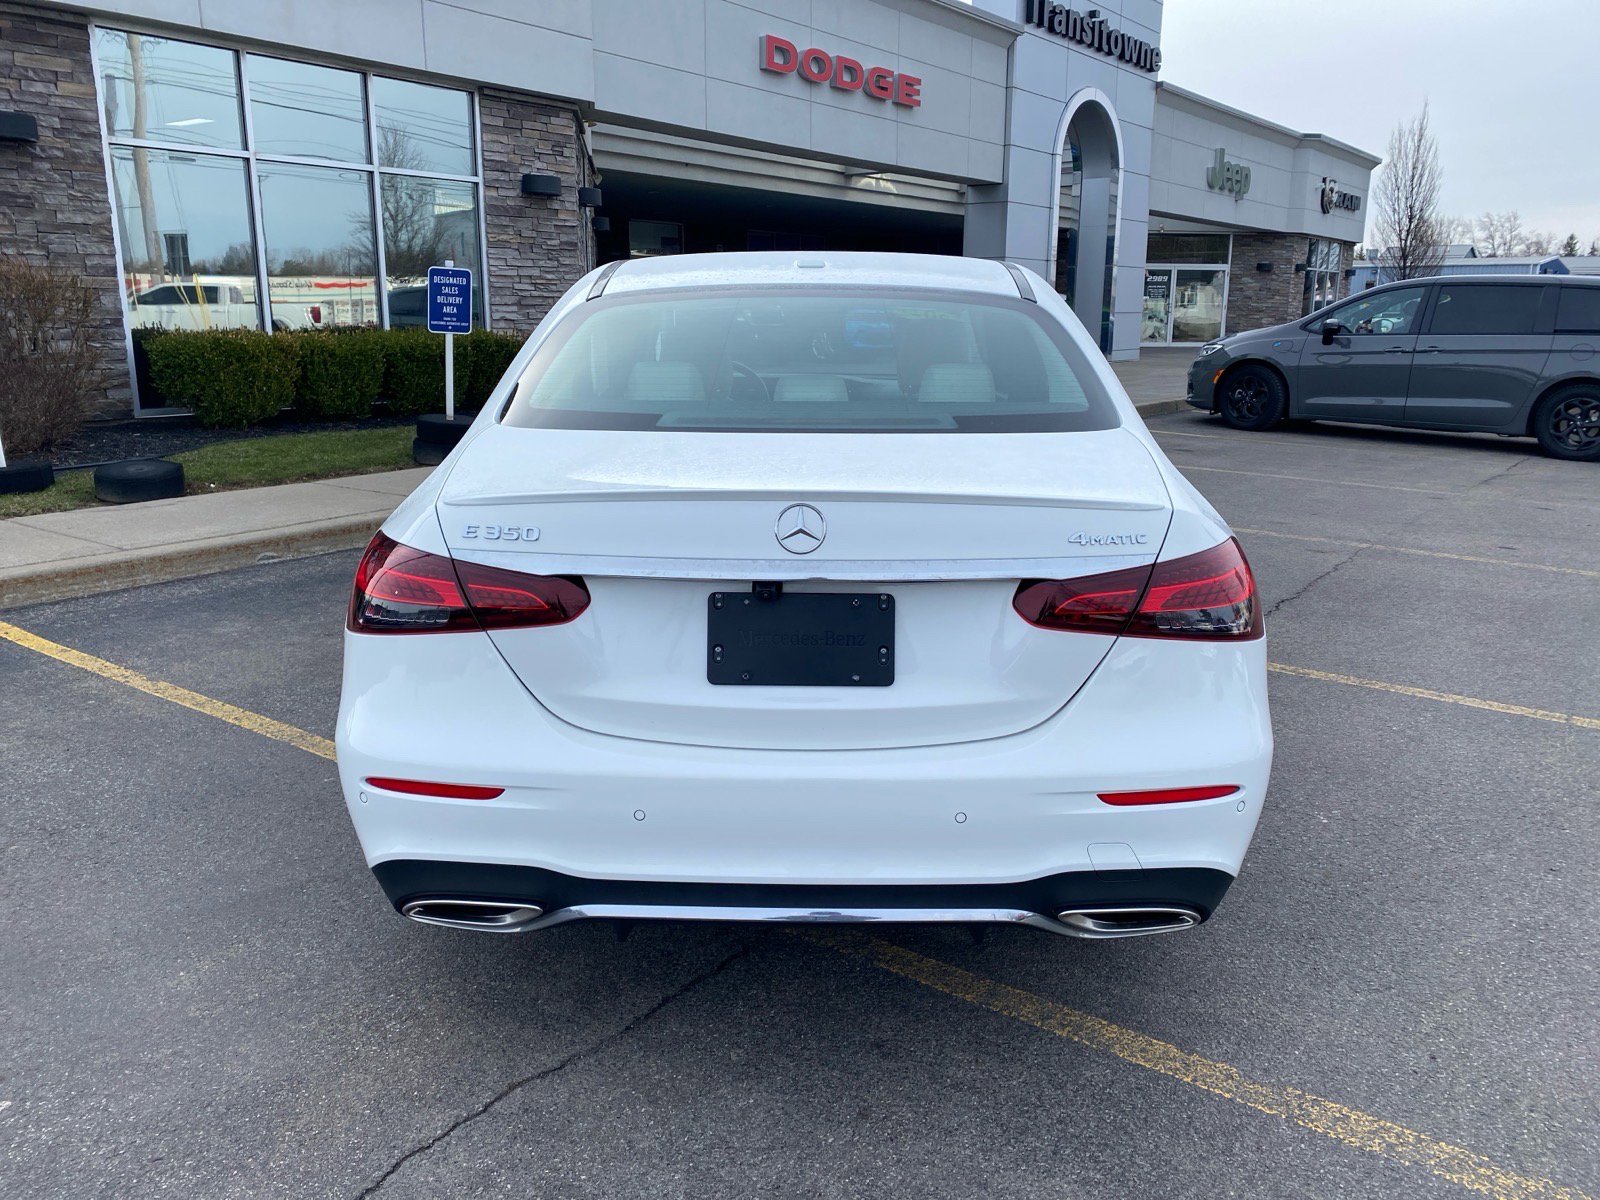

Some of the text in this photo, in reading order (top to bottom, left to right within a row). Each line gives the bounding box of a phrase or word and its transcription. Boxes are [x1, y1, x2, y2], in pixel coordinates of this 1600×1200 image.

[759, 34, 922, 107] DODGE
[1207, 148, 1251, 202] Jeep
[1335, 191, 1361, 210] RAM
[434, 275, 467, 285] DESIGNATED
[441, 286, 459, 294] SALES
[437, 295, 463, 304] DELIVERY
[462, 525, 541, 541] E 350
[1068, 530, 1148, 546] 4MATIC
[739, 629, 865, 647] Mercedes-Benz
